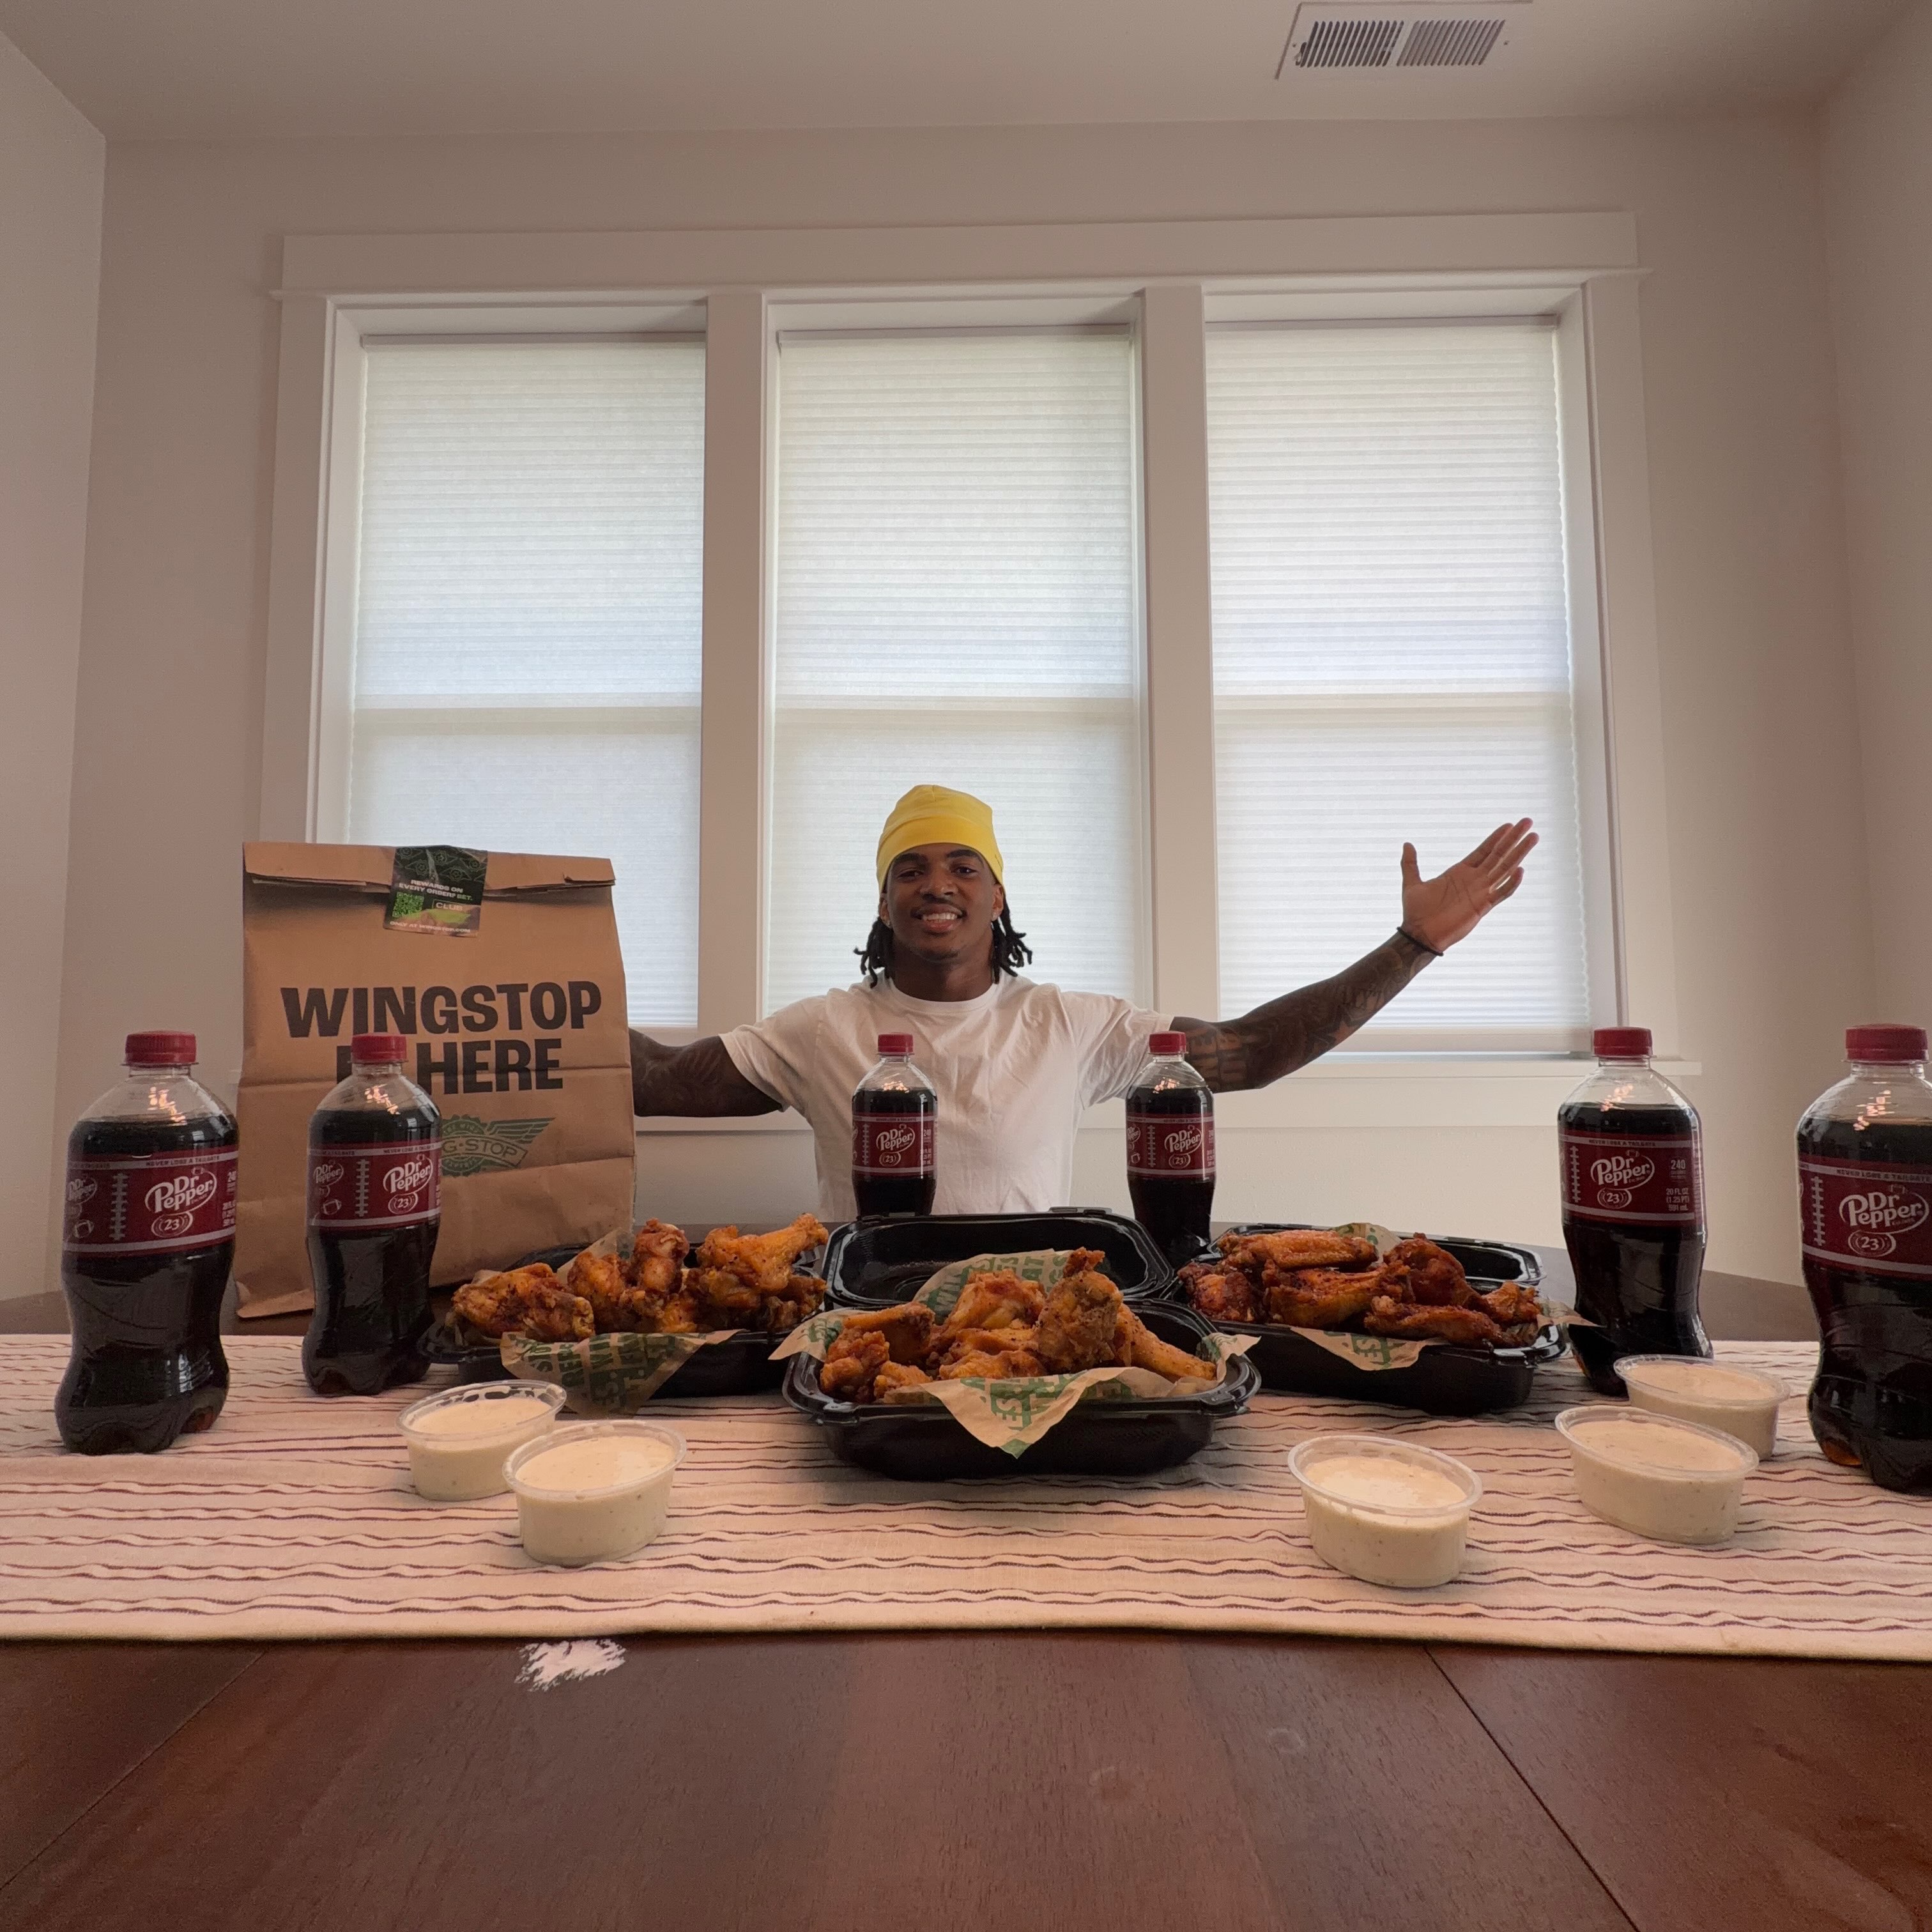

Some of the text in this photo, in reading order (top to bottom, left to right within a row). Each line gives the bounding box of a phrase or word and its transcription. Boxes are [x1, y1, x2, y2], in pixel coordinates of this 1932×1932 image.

[399, 882, 425, 892] EVERY
[411, 879, 450, 891] REWARDS
[436, 902, 463, 911] CLUB
[280, 981, 602, 1038] WINGSTOP
[416, 1038, 564, 1095] HERE
[876, 1131, 912, 1151] Pepper
[890, 1129, 904, 1140] Dr
[1179, 1130, 1193, 1142] Dr
[1164, 1133, 1200, 1153] Pepper
[885, 1155, 894, 1163] 23
[1175, 1157, 1184, 1165] 23
[1611, 1156, 1634, 1170] Dr
[1671, 1159, 1686, 1170] 240
[404, 1162, 422, 1176] Dr
[1590, 1159, 1650, 1186] Pepper
[174, 1176, 199, 1194] Dr
[383, 1166, 431, 1193] Pepper
[144, 1181, 213, 1213] Pepper
[397, 1198, 410, 1208] 23
[1606, 1192, 1620, 1204] 23
[1868, 1192, 1900, 1211] Dr
[1839, 1194, 1922, 1229] Pepper
[164, 1218, 180, 1230] 23
[1861, 1236, 1880, 1250] 23
